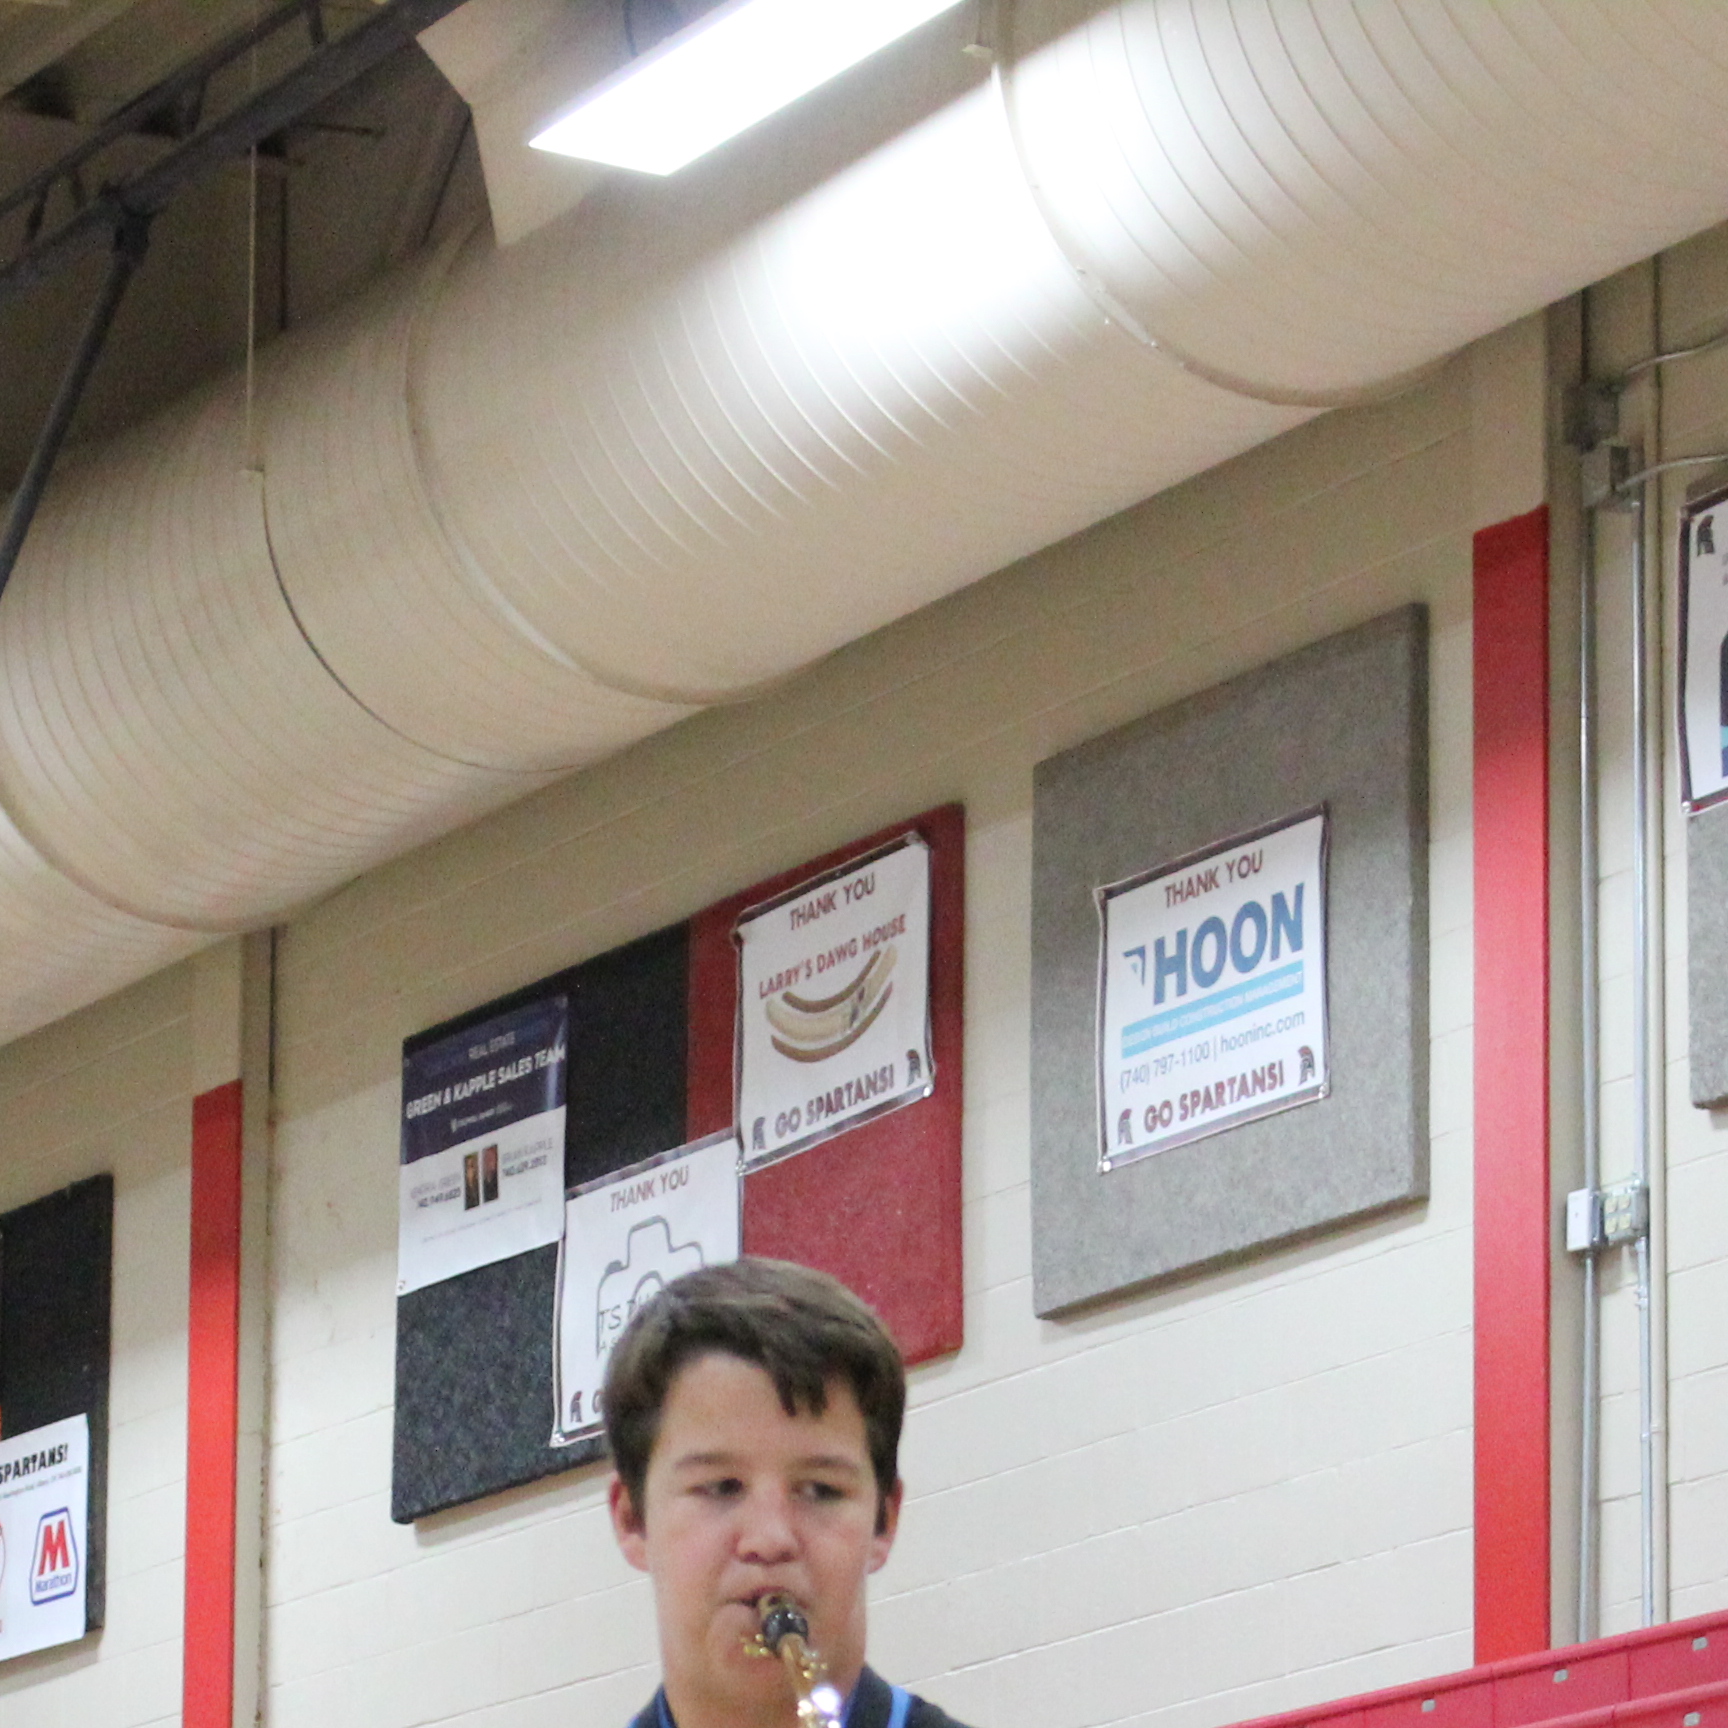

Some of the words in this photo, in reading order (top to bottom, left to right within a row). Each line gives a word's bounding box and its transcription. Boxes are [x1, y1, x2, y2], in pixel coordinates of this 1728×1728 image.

[789, 890, 838, 931] THANK
[843, 872, 876, 905] YOU
[1164, 866, 1219, 908] THANK
[1224, 849, 1263, 883] YOU
[760, 959, 812, 999] LARRY'S
[816, 938, 858, 976] DAWG
[862, 914, 906, 949] HOUSE
[1153, 881, 1304, 1006] HOON
[406, 1087, 442, 1119] GREEN
[443, 1087, 452, 1105] &
[453, 1069, 496, 1102] KAPPLE
[498, 1055, 533, 1085] SALES
[535, 1042, 566, 1070] TEAM
[1121, 1064, 1150, 1093] (740)
[1153, 1040, 1210, 1078] 797-1100
[1220, 1010, 1305, 1054] hooninc.com
[774, 1107, 801, 1138] GO
[1144, 1100, 1172, 1133] GO
[610, 1178, 655, 1213] THANK
[659, 1165, 689, 1193] YOU
[35, 1573, 72, 1594] Marathon
